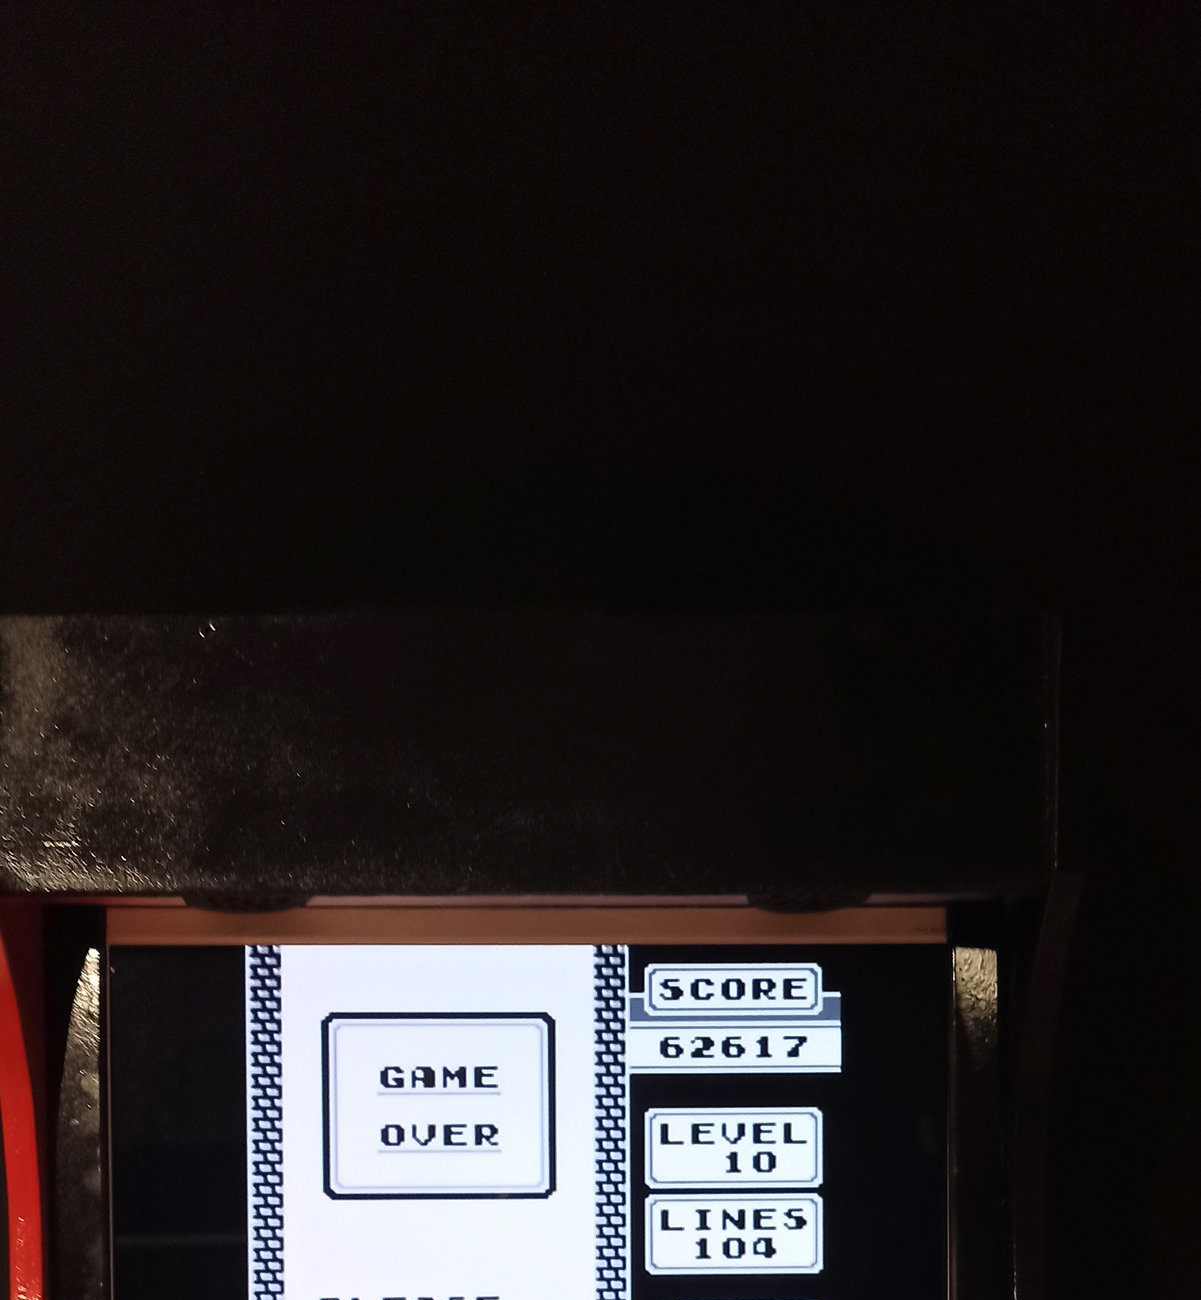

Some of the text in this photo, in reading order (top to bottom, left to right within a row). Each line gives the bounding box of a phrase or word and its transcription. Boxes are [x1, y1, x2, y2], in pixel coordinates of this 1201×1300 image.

[660, 978, 807, 1001] SCORE
[660, 1036, 807, 1059] 62617
[380, 1065, 499, 1089] GAME
[380, 1123, 499, 1147] OVER
[660, 1122, 807, 1145] LEVEL
[726, 1151, 777, 1174] 10
[660, 1208, 807, 1231] LINES
[695, 1237, 777, 1260] 104
